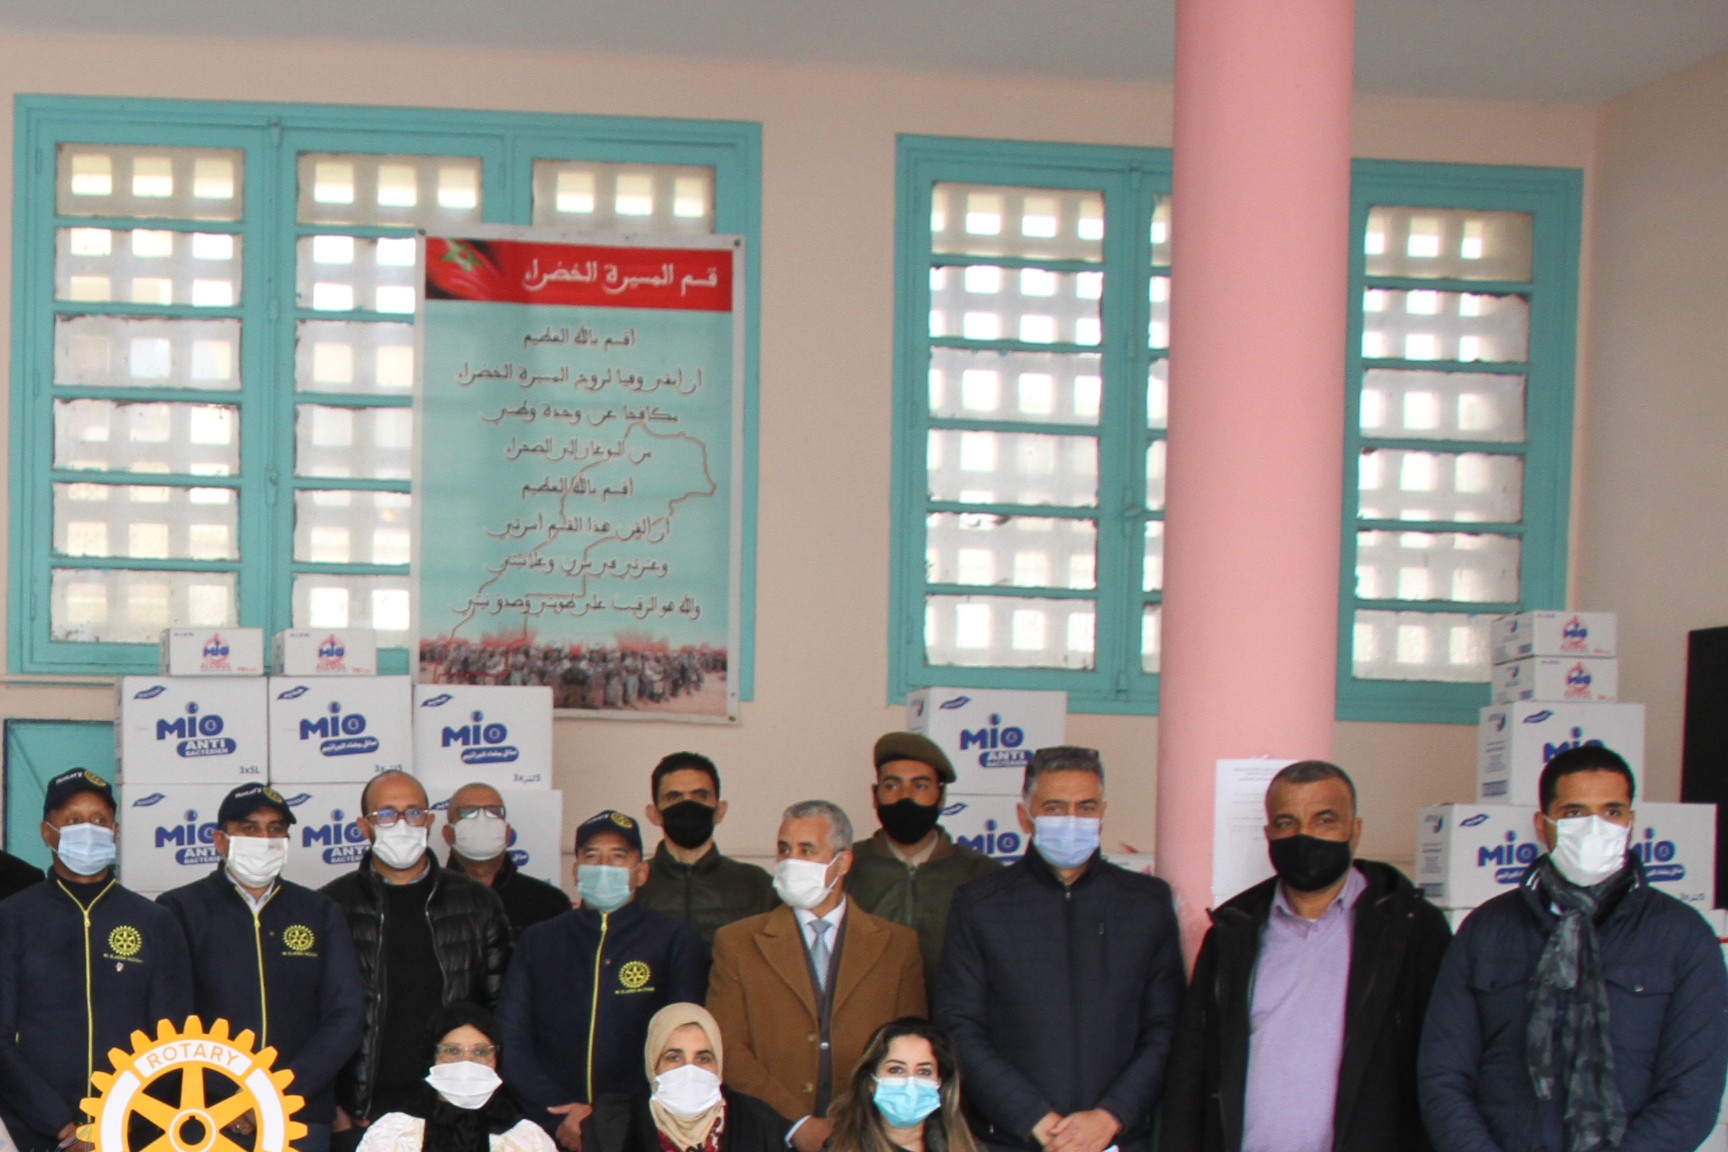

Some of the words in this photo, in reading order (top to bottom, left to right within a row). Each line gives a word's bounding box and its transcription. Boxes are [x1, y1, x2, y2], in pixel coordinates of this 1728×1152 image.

[522, 258, 598, 291] الخضراء
[602, 263, 674, 294] المسيرة
[681, 267, 718, 296] قسم
[186, 738, 226, 750] ANTI
[184, 847, 216, 857] ANT
[146, 1043, 240, 1069] ROTARY
